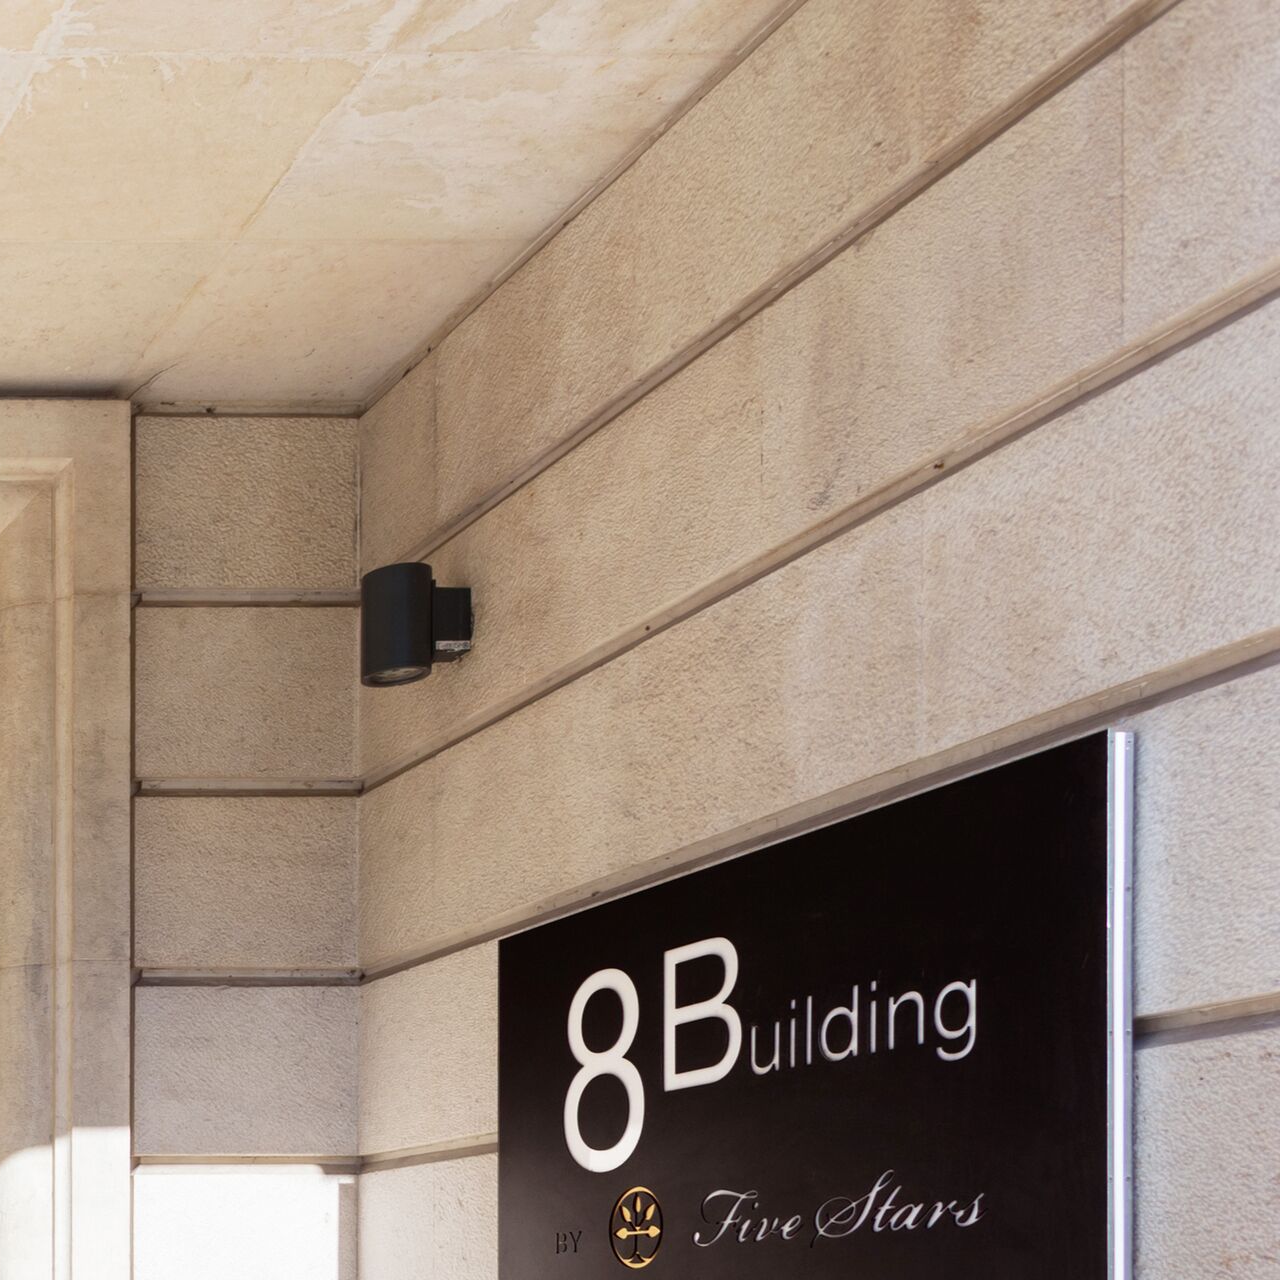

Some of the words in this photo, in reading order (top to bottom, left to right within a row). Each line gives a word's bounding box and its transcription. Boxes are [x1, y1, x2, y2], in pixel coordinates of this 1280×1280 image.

[663, 936, 977, 1092] Building
[555, 1231, 582, 1254] BY
[693, 1189, 802, 1248] Five
[811, 1169, 985, 1248] Stars
